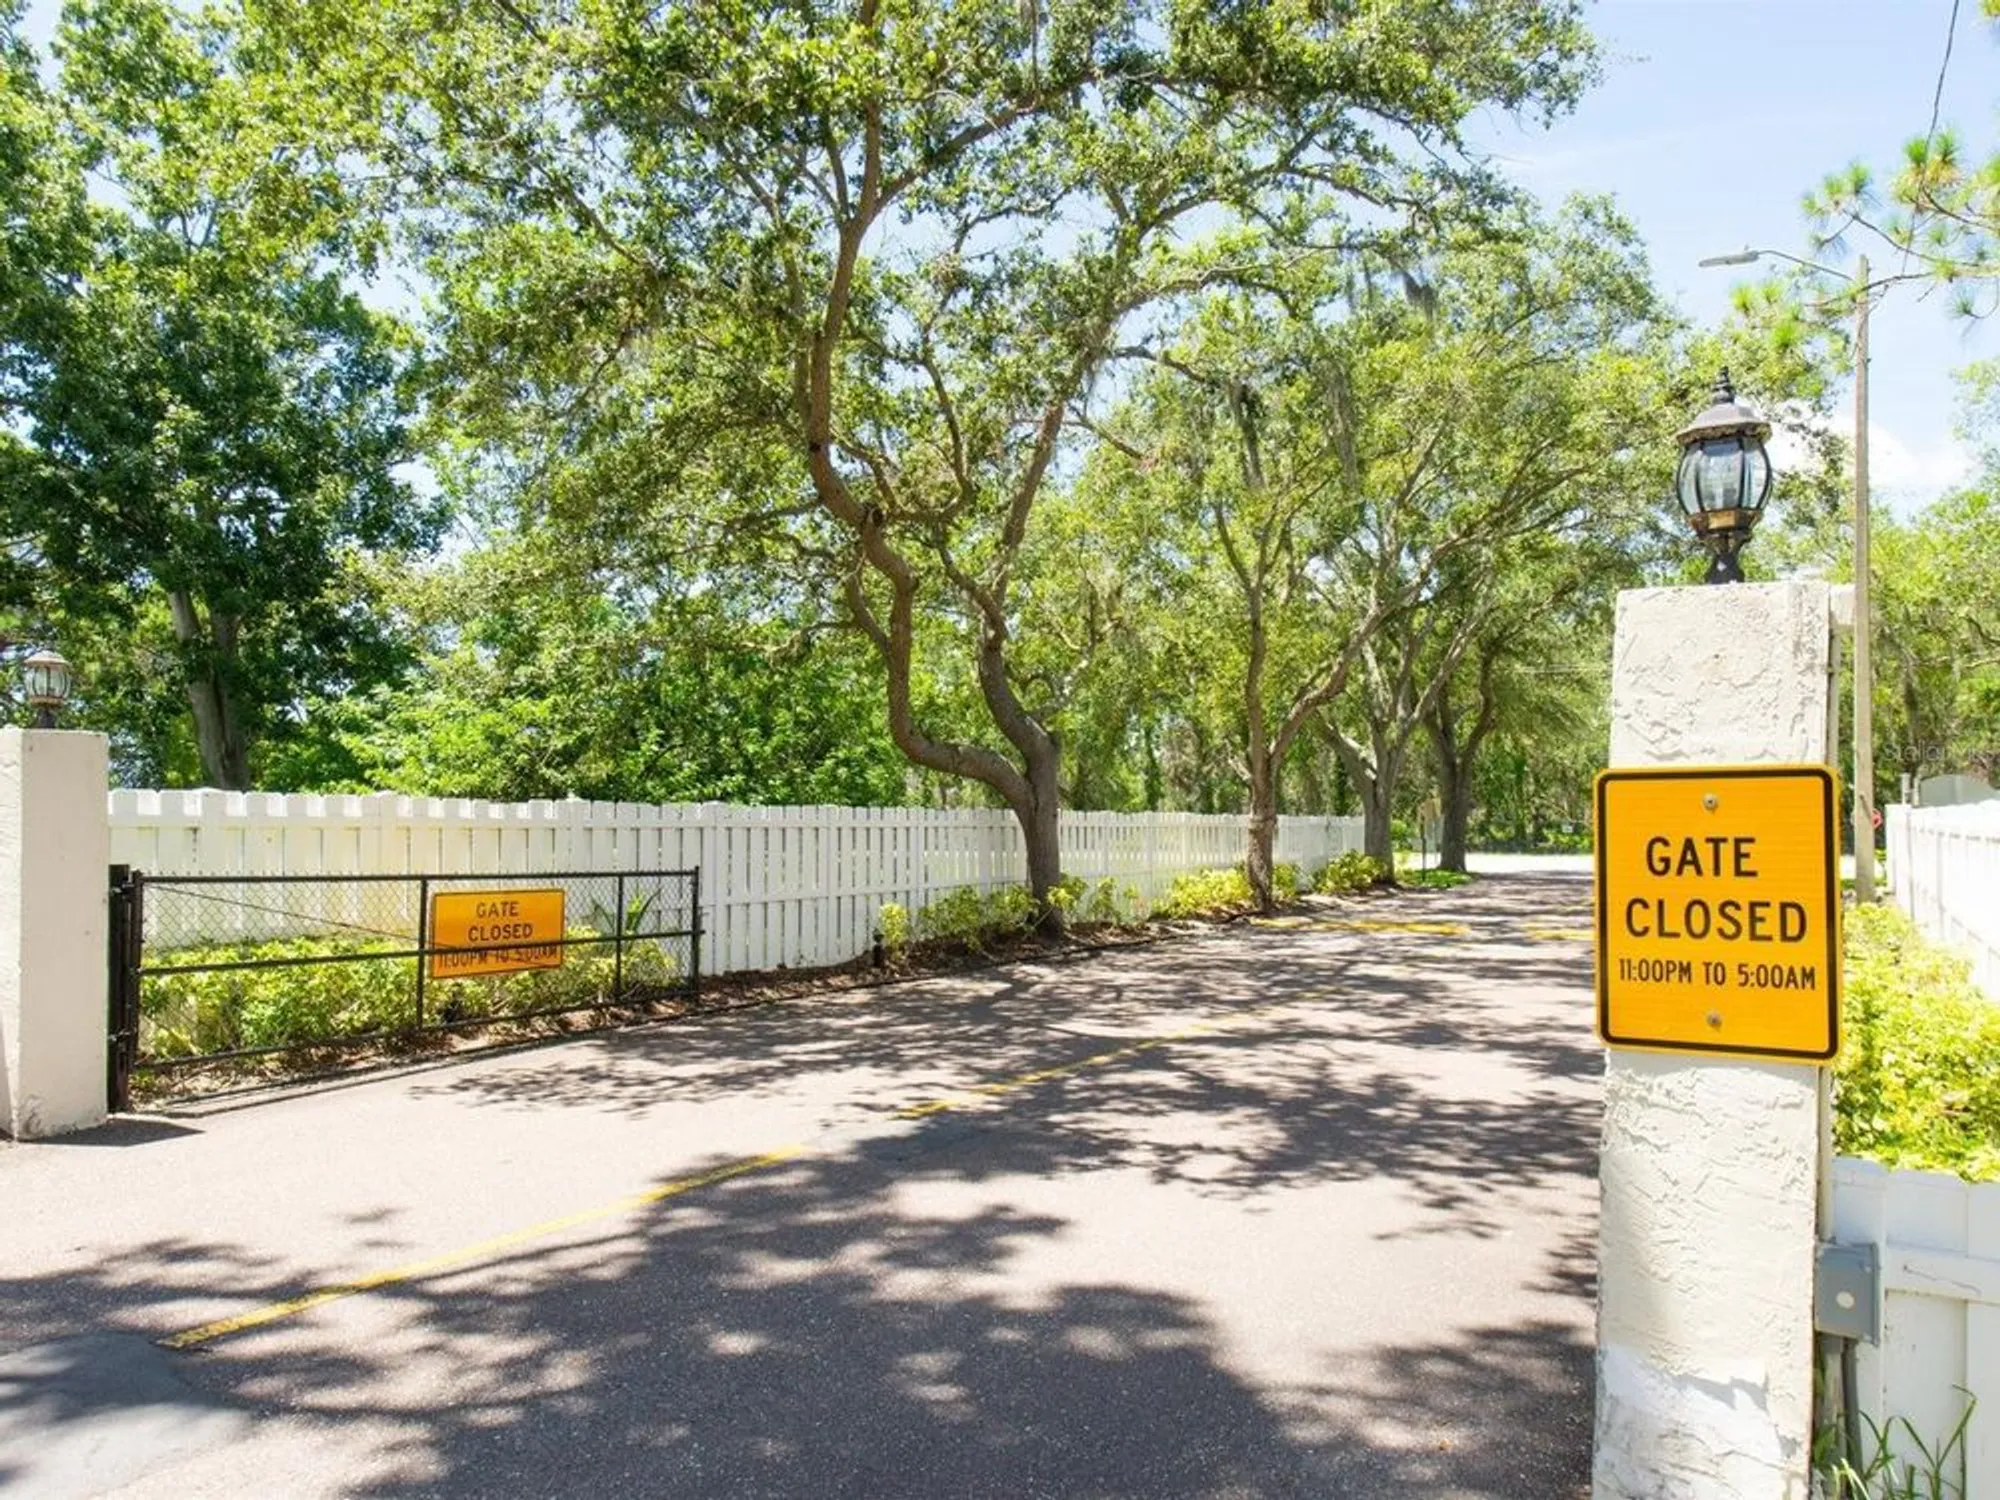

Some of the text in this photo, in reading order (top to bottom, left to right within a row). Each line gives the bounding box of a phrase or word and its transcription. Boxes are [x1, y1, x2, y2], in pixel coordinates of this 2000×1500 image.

[1647, 837, 1758, 877] GATE
[476, 901, 519, 919] GATE
[1626, 897, 1807, 942] CLOSED
[468, 923, 533, 942] CLOSED
[1619, 958, 1815, 990] 11:00PM TO 5:00AM
